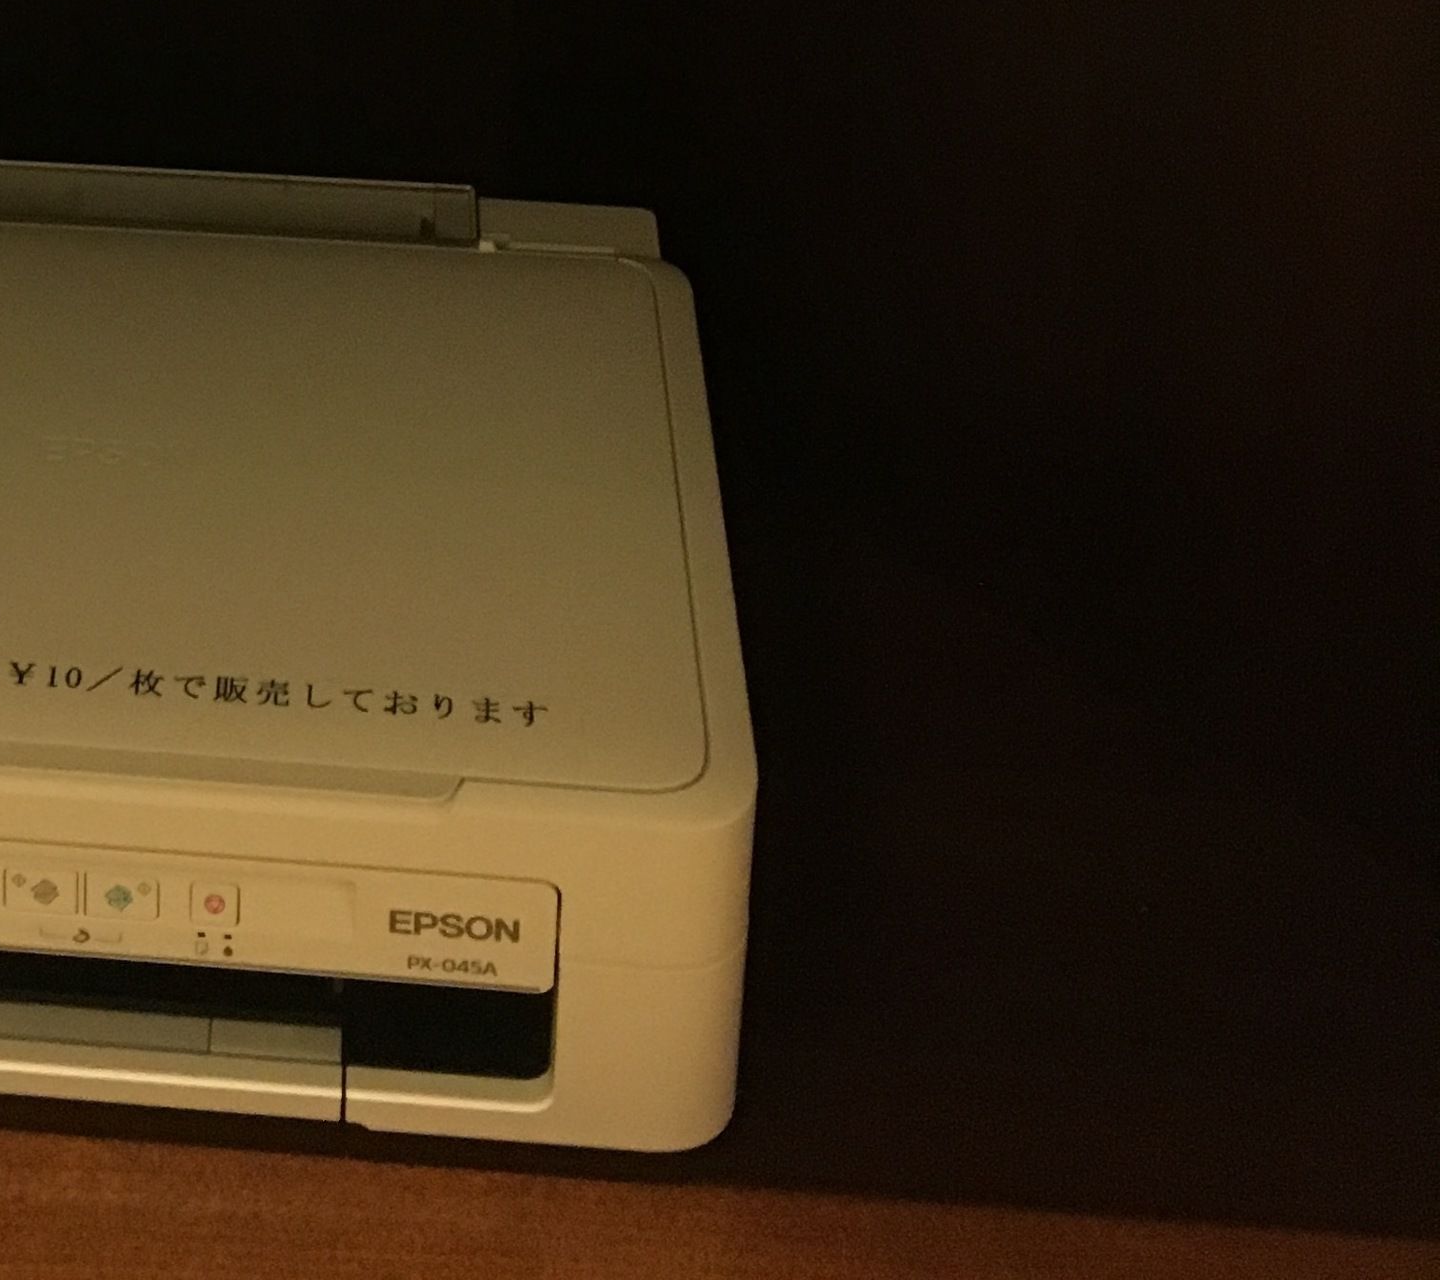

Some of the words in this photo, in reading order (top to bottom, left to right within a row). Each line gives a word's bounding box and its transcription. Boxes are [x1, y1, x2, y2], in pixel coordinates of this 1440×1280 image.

[41, 435, 196, 468] EPSO
[389, 909, 521, 943] EPSON
[407, 954, 498, 977] PX-045A
